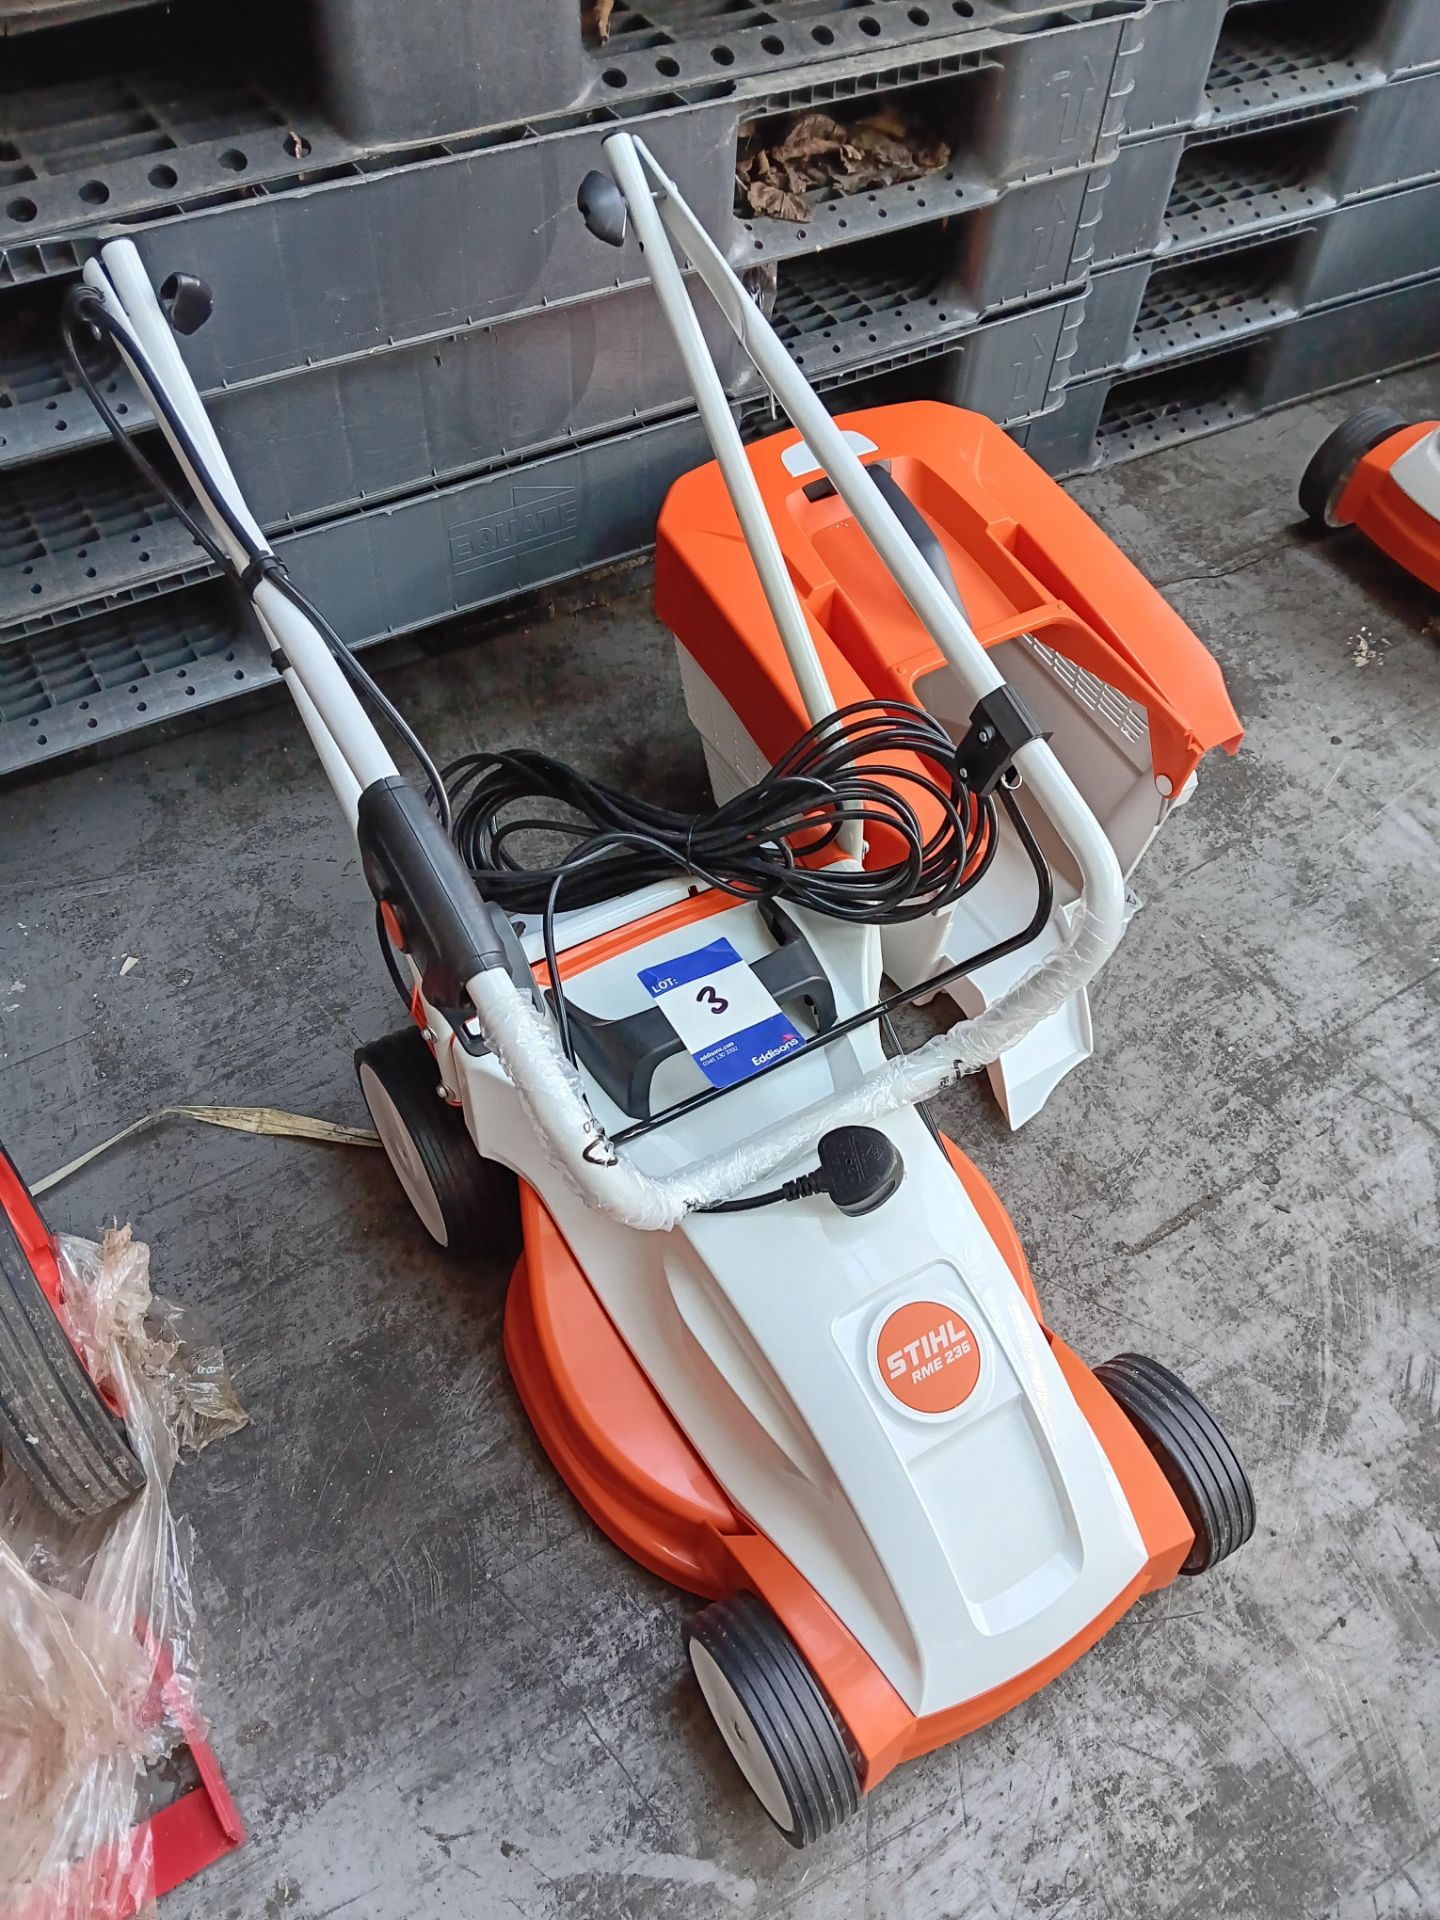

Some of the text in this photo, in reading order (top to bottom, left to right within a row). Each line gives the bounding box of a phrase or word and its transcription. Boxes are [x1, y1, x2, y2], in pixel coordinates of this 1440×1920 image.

[449, 500, 577, 563] EQUATE
[651, 976, 679, 994] LOT:
[696, 985, 729, 1015] 3
[700, 1041, 735, 1062] eddisons.com
[751, 1038, 799, 1066] Eddisons
[886, 1320, 967, 1380] STIHL
[911, 1340, 972, 1385] RME 235
